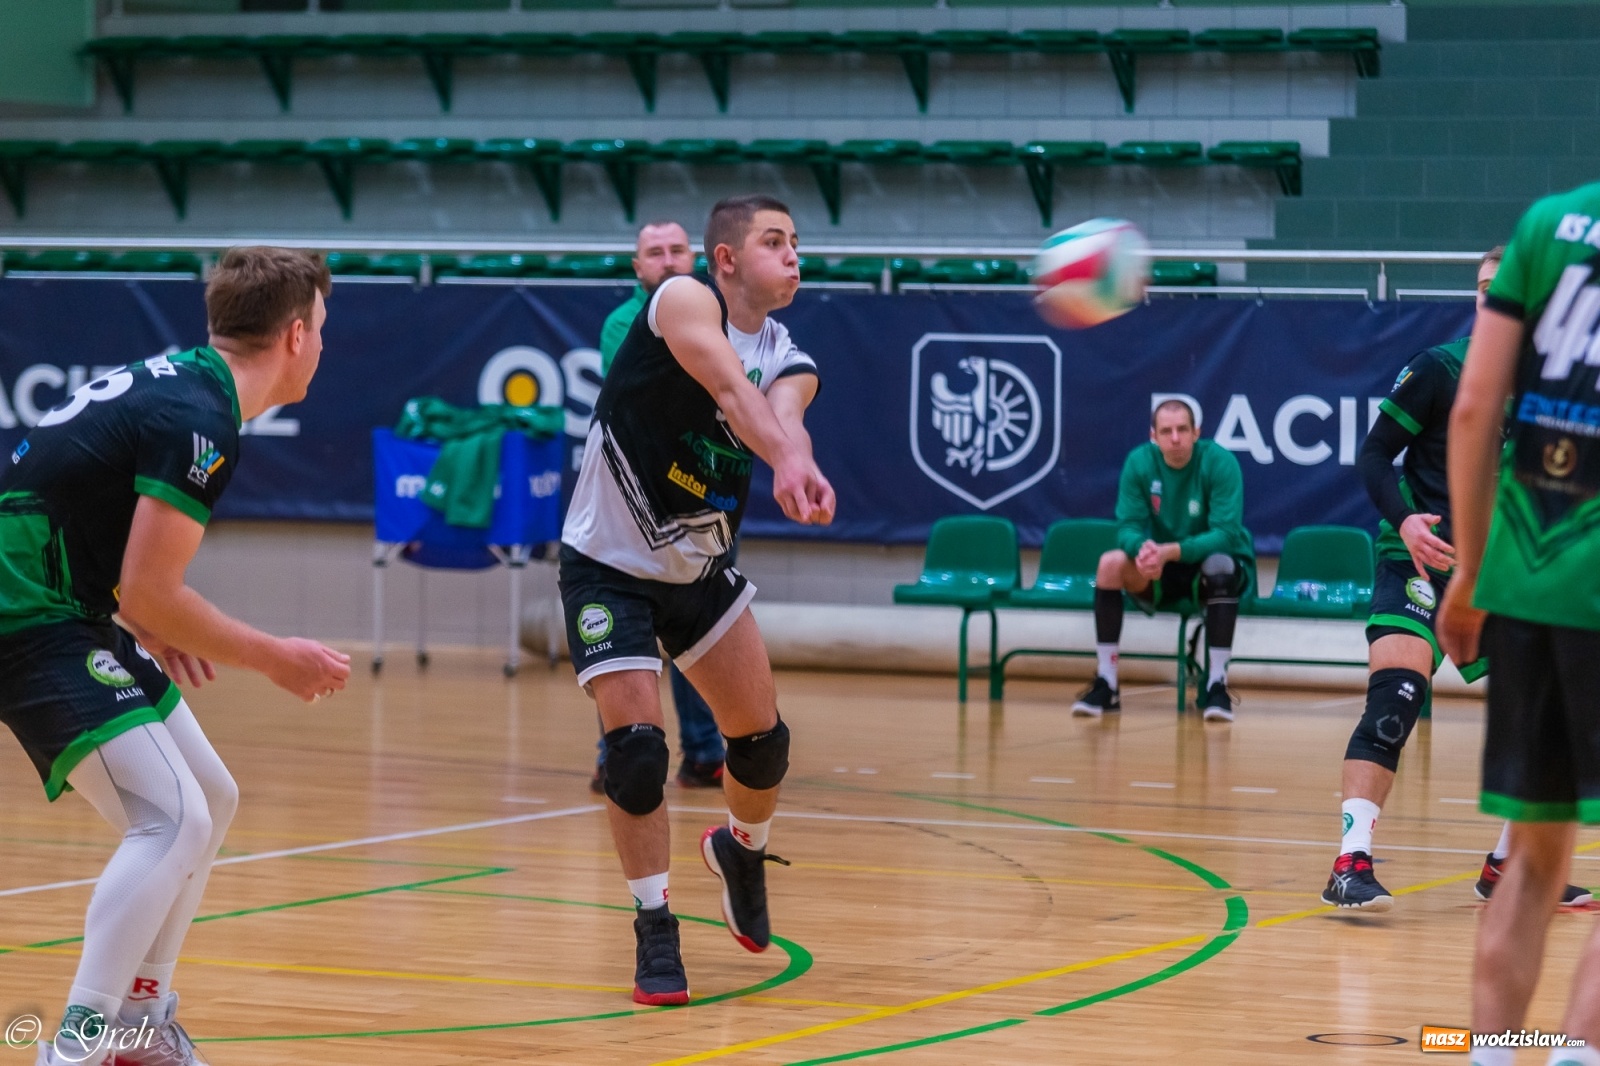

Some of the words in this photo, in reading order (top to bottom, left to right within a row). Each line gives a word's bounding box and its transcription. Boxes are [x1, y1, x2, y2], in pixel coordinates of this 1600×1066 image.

[190, 464, 209, 484] PCS
[1405, 603, 1431, 620] ALLSIX
[585, 640, 613, 657] ALLSIX
[132, 977, 160, 995] R
